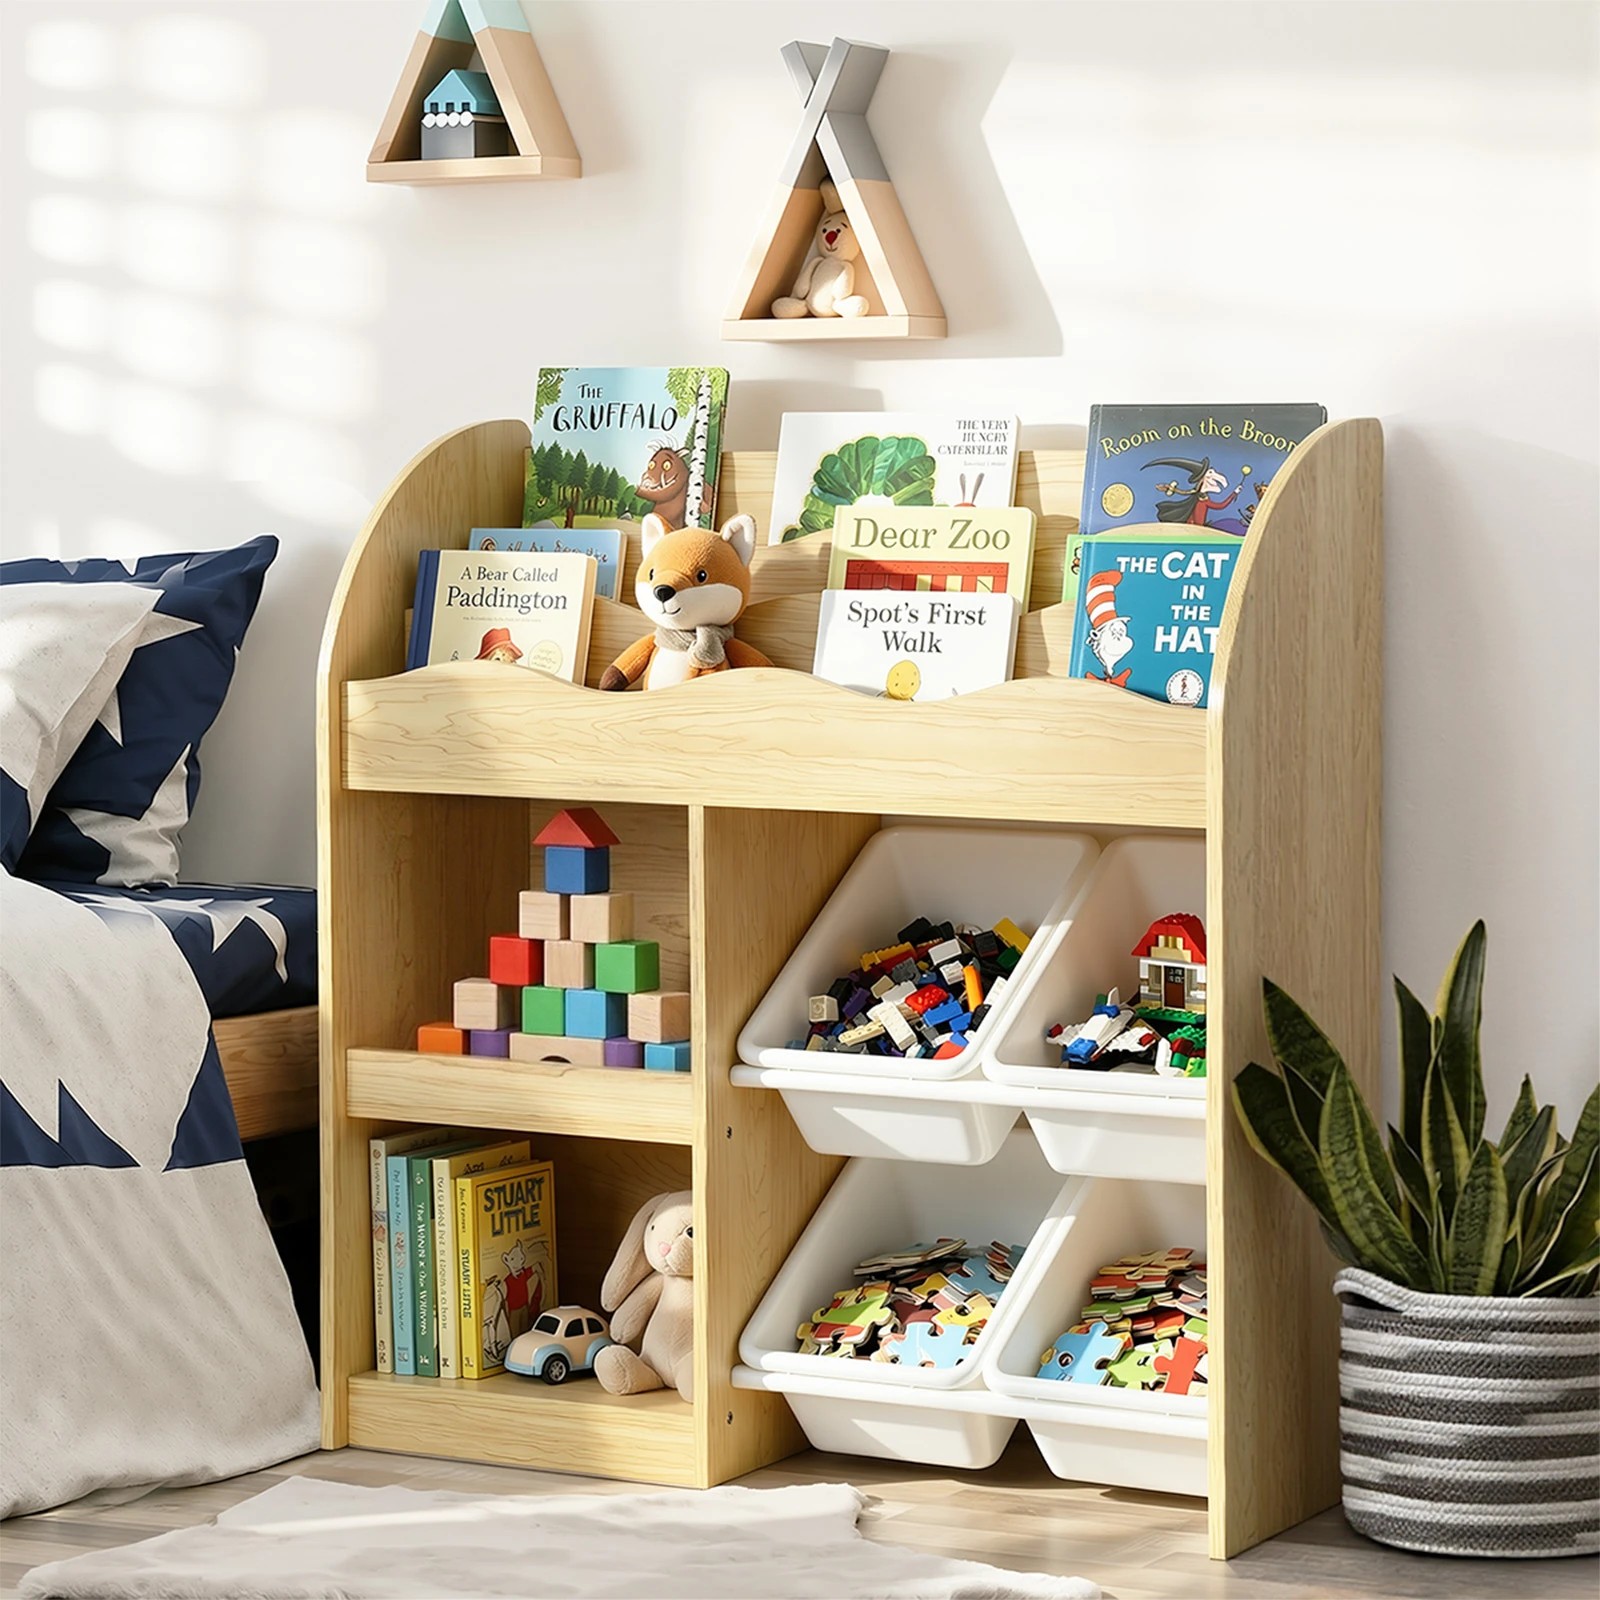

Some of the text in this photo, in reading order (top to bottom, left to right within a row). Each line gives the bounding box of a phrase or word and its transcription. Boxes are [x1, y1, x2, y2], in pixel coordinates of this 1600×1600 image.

[577, 383, 603, 399] THE
[553, 402, 678, 431] GRUFFALO
[955, 419, 1011, 430] THE VERY
[937, 444, 1008, 455] CATERPILLAR
[962, 432, 1008, 442] HUNGRY
[1100, 428, 1161, 459] Room
[1168, 424, 1193, 439] on
[1199, 417, 1232, 438] the
[850, 517, 1011, 550] Dear Zoo
[460, 566, 558, 582] A Bear Called
[1116, 551, 1230, 579] THE CAT
[446, 585, 568, 615] Paddington
[1181, 584, 1205, 600] IN
[847, 600, 987, 629] Spot's First
[1171, 605, 1211, 621] THE
[882, 630, 943, 653] Walk
[1154, 625, 1220, 654] HAT
[484, 1176, 545, 1213] STUART
[491, 1203, 541, 1237] LITTLE
